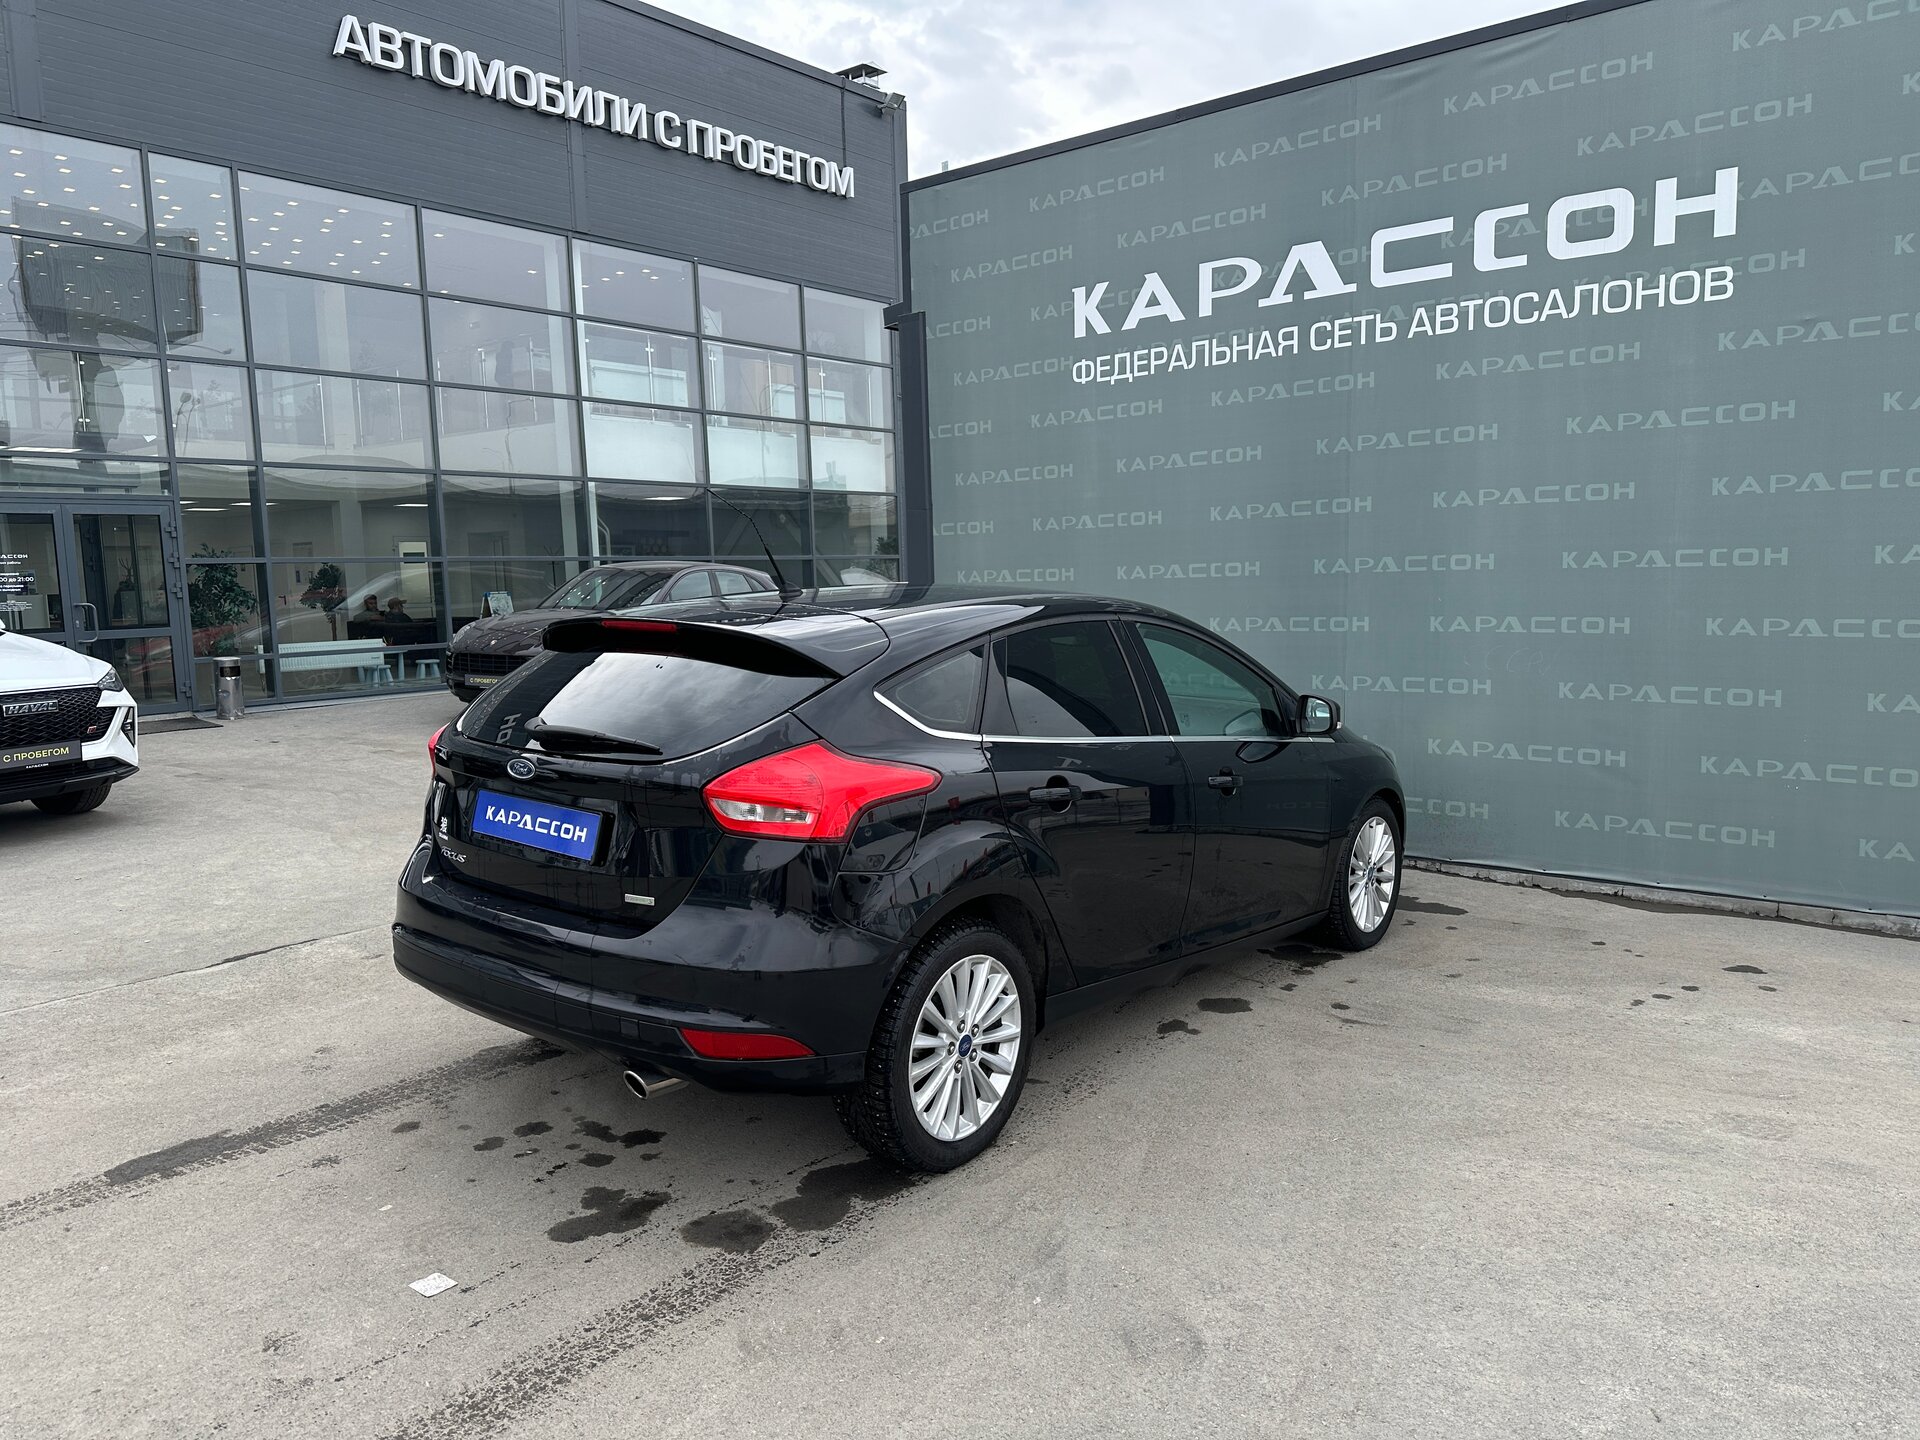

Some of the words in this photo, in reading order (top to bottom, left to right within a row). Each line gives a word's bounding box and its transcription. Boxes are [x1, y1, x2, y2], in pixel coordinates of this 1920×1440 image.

[1443, 51, 1653, 115] КАРАССОН
[333, 14, 647, 140] АВТОМОБИЛИ
[655, 110, 681, 149] С
[687, 119, 855, 199] ПРОБЕГОМ
[1577, 93, 1812, 156] КАРАССОН
[1214, 114, 1382, 169] КАРАССОН
[1028, 166, 1165, 213] КАРАССОН
[1321, 153, 1507, 207] КАРАССОН
[1117, 203, 1267, 249] КАРАССОН
[950, 244, 1073, 283] КАРАССОН
[1072, 167, 1738, 338] КАРАССОН
[1072, 326, 1299, 385] ФЕДЕРАЛЬНАЯ
[1309, 312, 1397, 352] СЕТЬ
[1407, 265, 1734, 338] АВТОСАЛОНОВ
[1717, 312, 1920, 352] КАРАСС
[954, 356, 1074, 386] КАРАССОН
[1435, 341, 1641, 380] КАРАССОН
[1211, 372, 1375, 407] КАРАССОН
[1031, 398, 1163, 429] КАРАССОН
[1566, 399, 1796, 435] КАРАССОН
[1316, 423, 1498, 456] КАРАССОН
[1117, 445, 1262, 473] КАРАССОН
[955, 463, 1074, 487] КАРАССОН
[1210, 496, 1372, 522] КАРАССОН
[1432, 481, 1636, 509] КАРАССОН
[1032, 510, 1162, 533] КАРАССОН
[1117, 561, 1261, 580] КАРАССОН
[1314, 553, 1495, 575] КАРАССОН
[1562, 546, 1789, 569] КАРАССОН
[957, 567, 1074, 585] КАРАССОН
[1209, 616, 1370, 633] КАРАССОН
[1429, 616, 1631, 635] КАРАССОН
[1311, 675, 1492, 695] КАРАССОН
[1558, 682, 1782, 708] КАРАССОН
[8, 701, 57, 715] HAVAL
[3, 754, 11, 763] С
[13, 746, 70, 761] ПРОБЕГОМ
[1427, 738, 1626, 768] КАРАССОН
[485, 805, 588, 843] КАРАССОН
[1555, 809, 1775, 848] КАРАССОН
